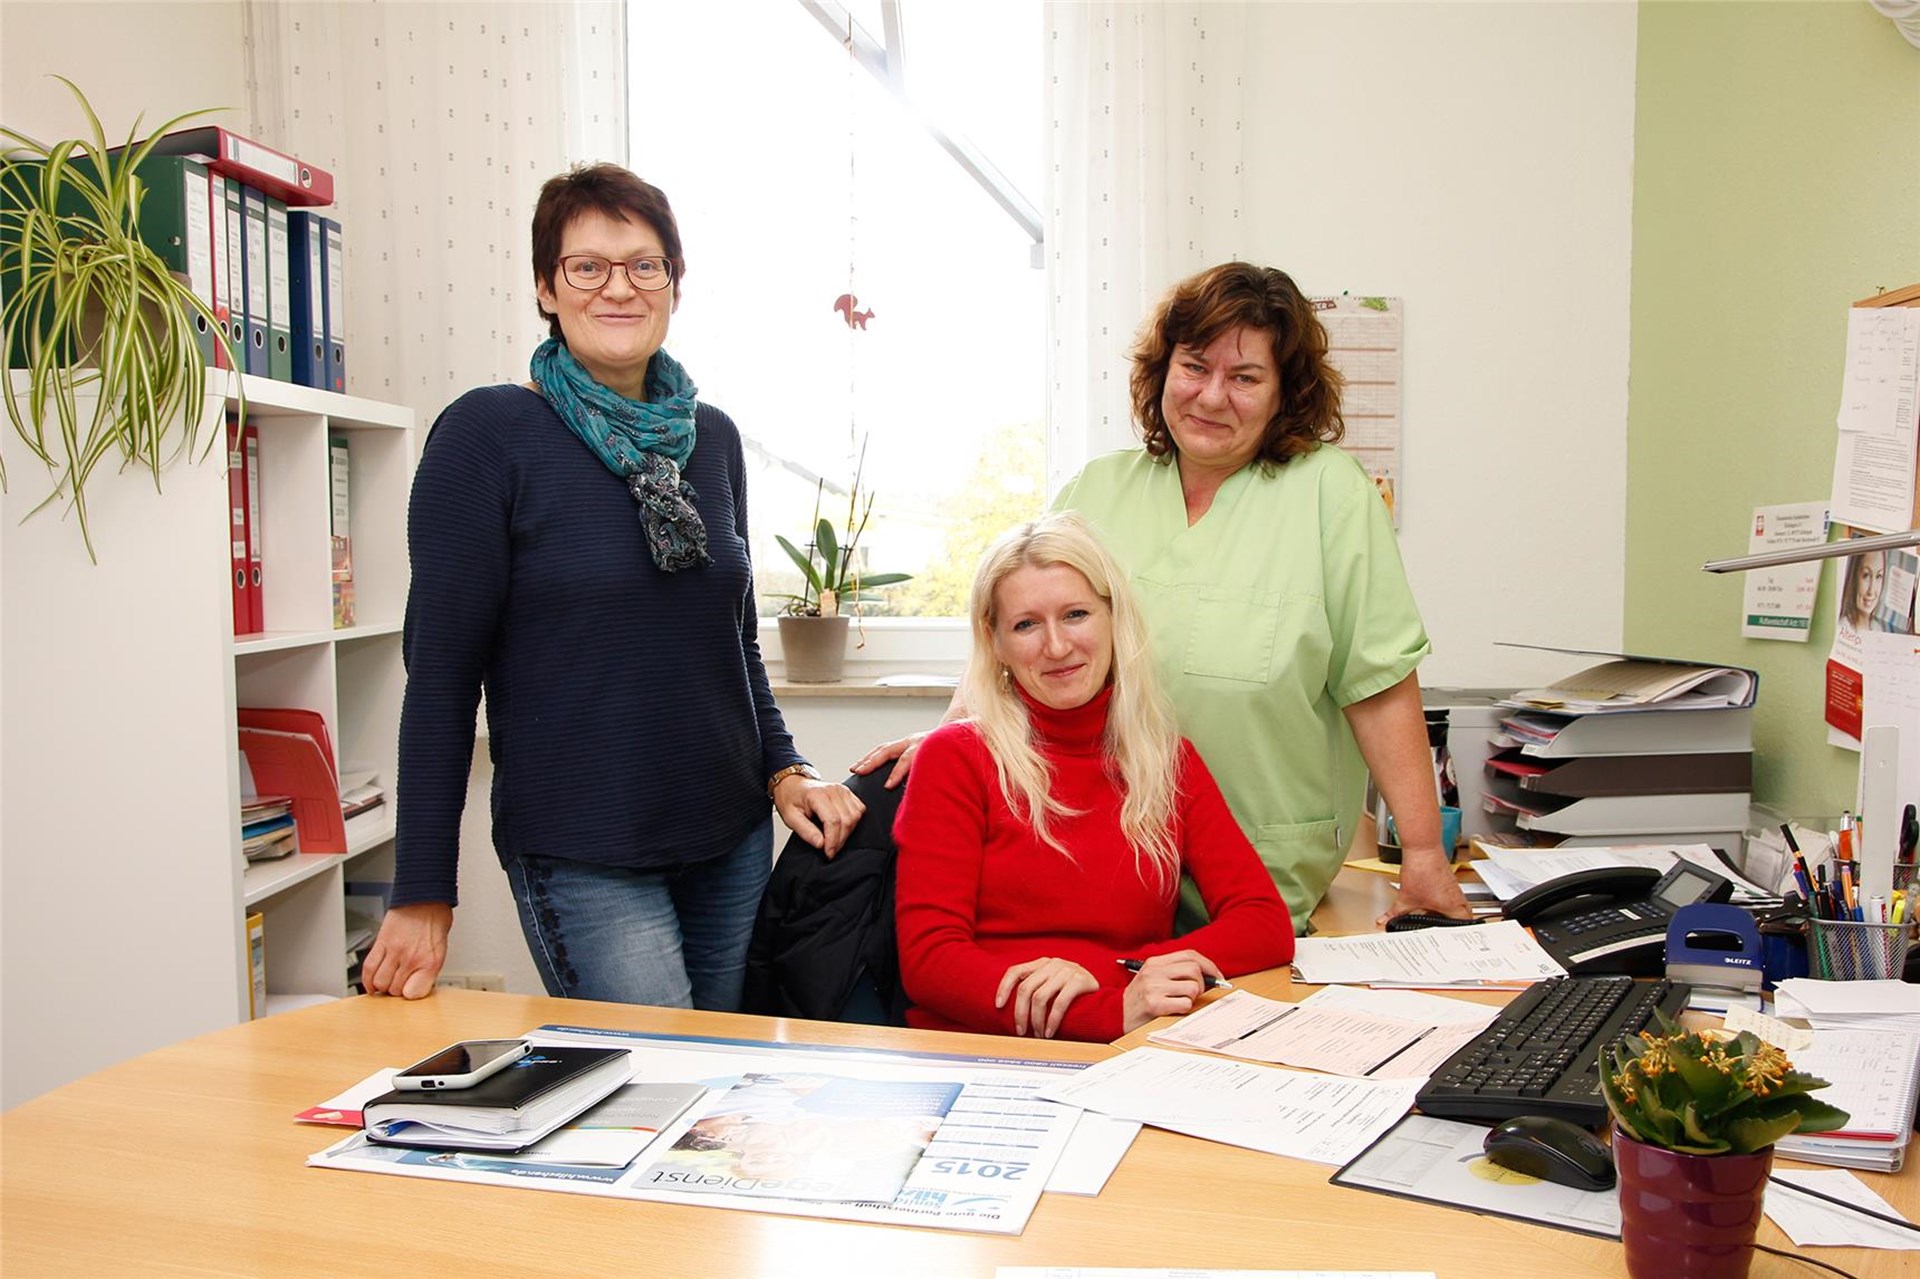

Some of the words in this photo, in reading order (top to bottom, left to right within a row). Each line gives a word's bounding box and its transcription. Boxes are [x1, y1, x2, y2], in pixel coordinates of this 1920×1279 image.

[1730, 957, 1752, 966] LEITZ
[931, 1161, 1028, 1181] 2015
[979, 1212, 1001, 1220] Die
